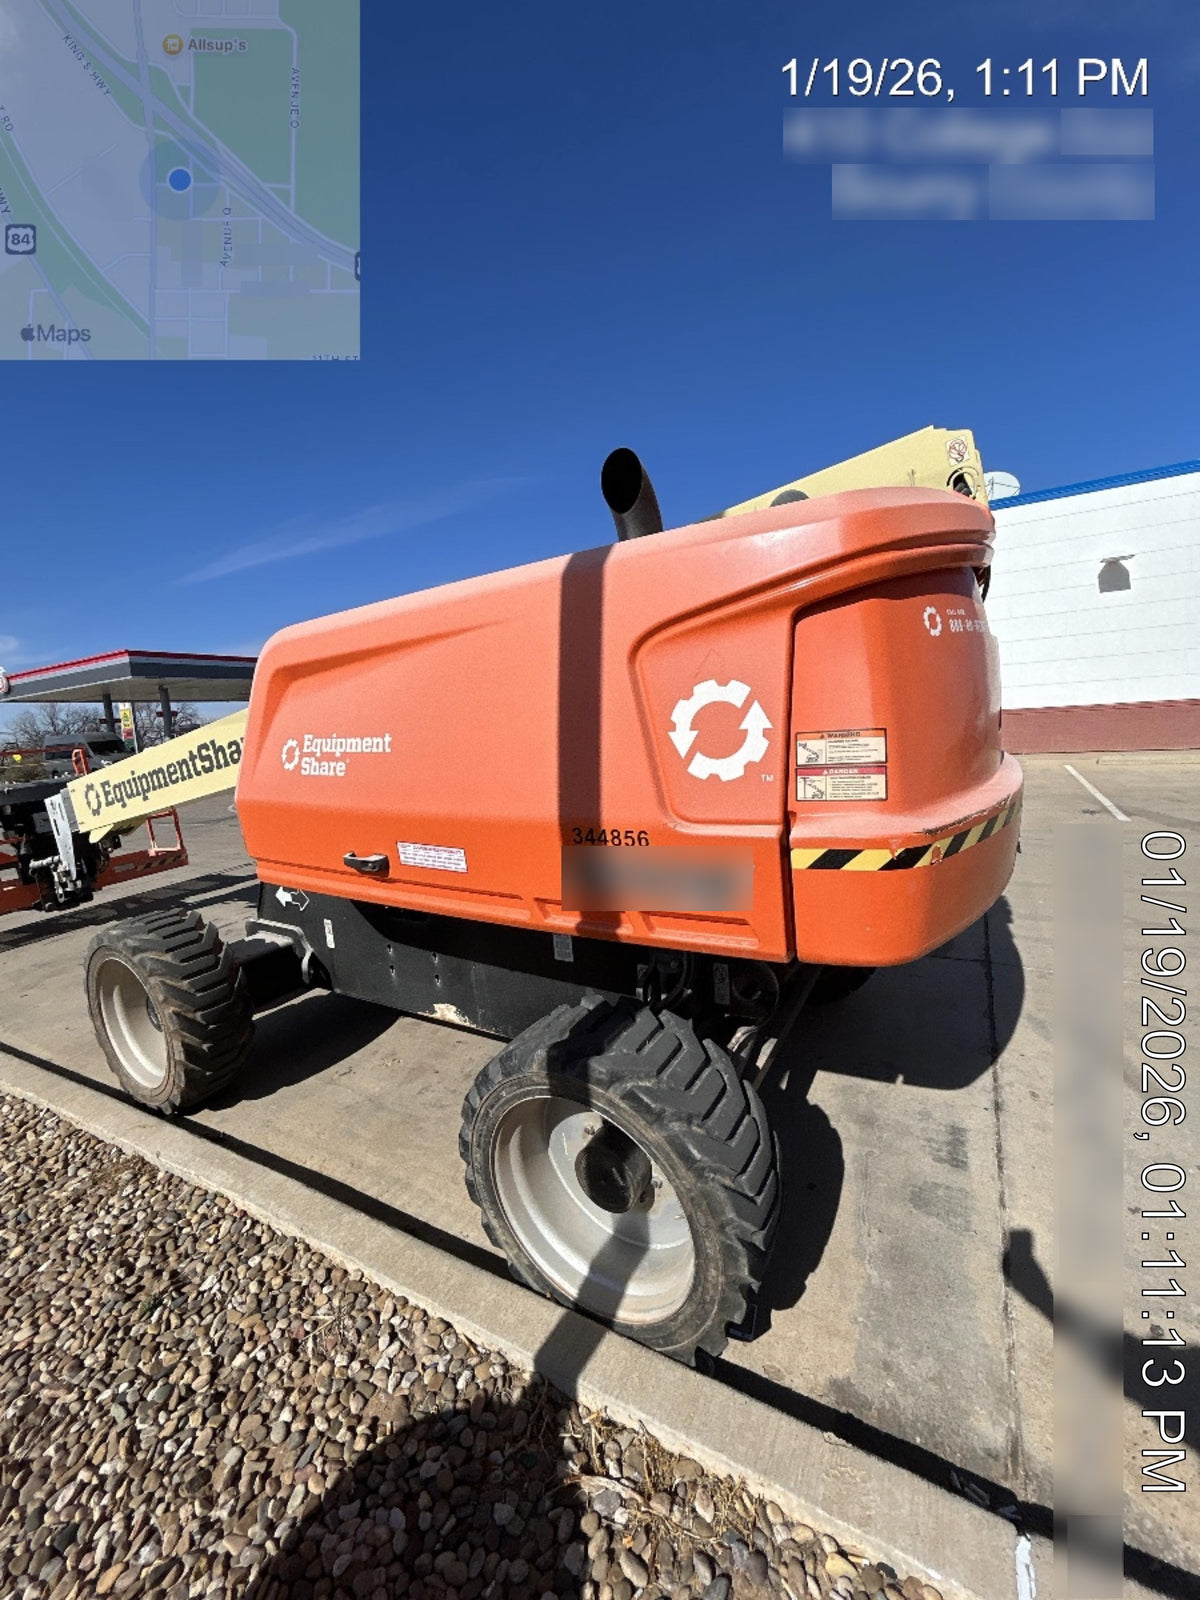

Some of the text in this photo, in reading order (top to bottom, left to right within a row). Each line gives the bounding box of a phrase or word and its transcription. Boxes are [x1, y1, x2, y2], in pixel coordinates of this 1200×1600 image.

[303, 733, 392, 757] Equipment
[101, 738, 246, 808] EquipmentSha
[301, 757, 346, 777] Share
[761, 774, 774, 782] TM
[572, 827, 650, 847] 344856
